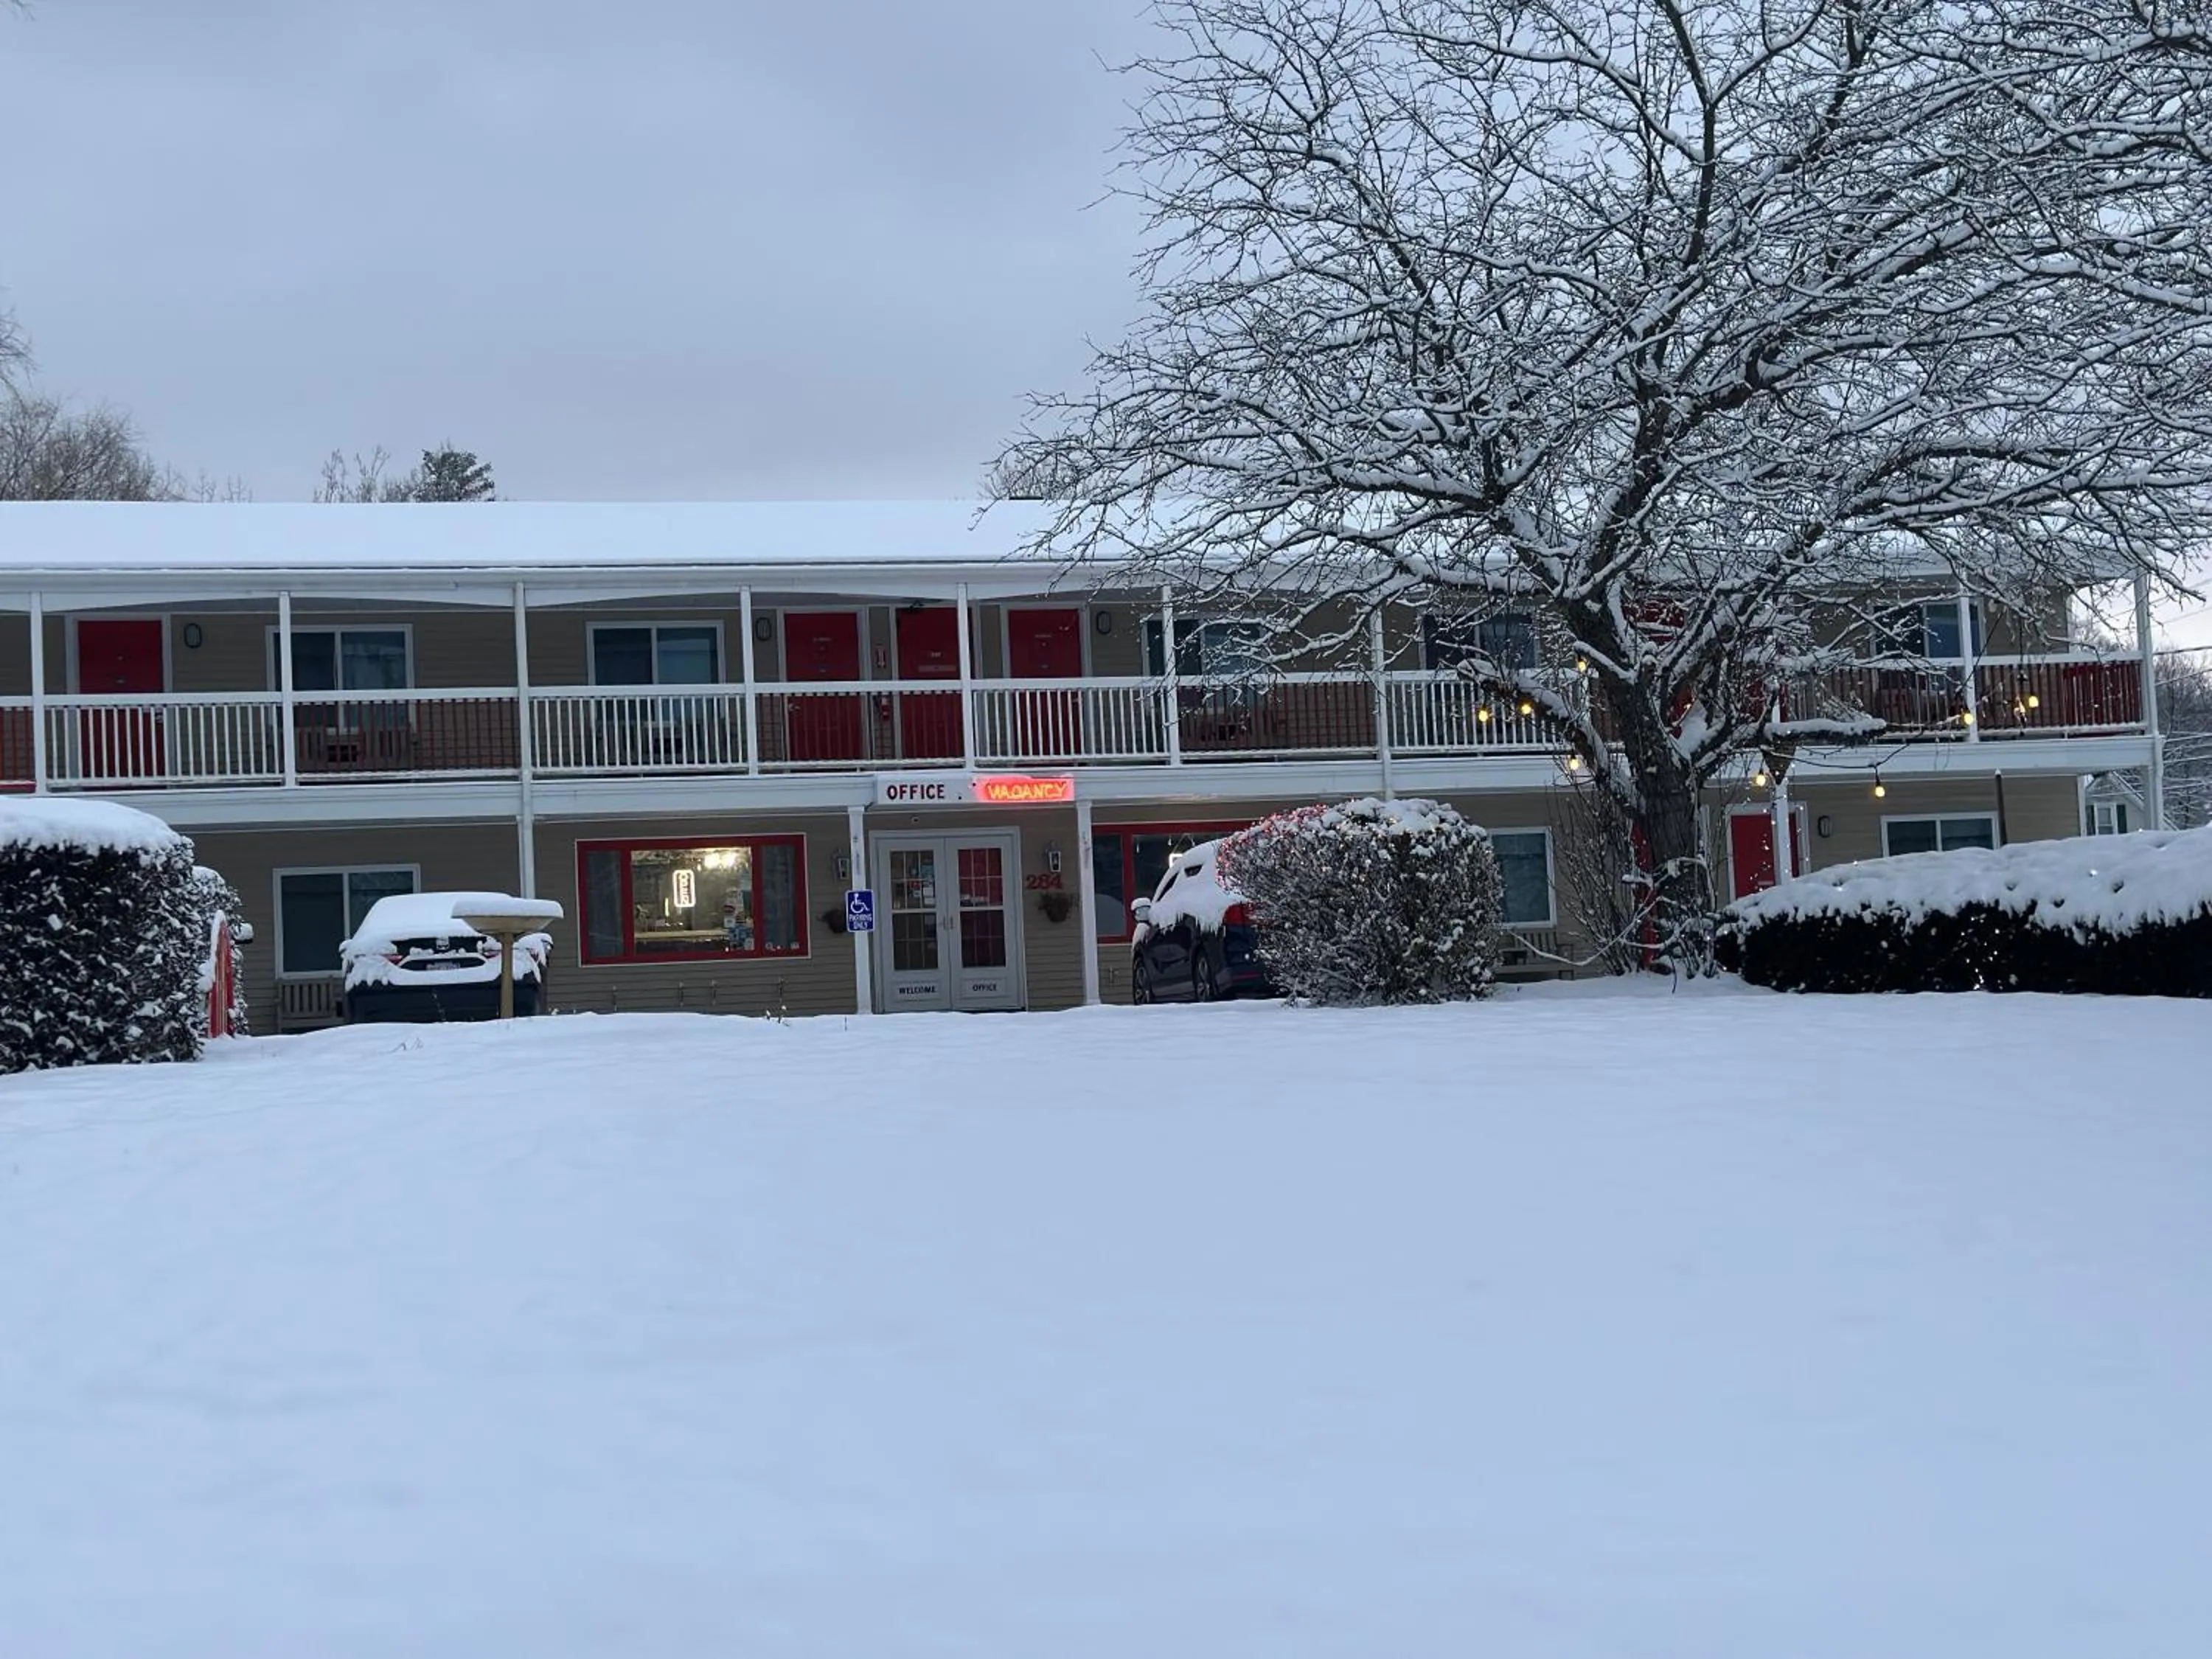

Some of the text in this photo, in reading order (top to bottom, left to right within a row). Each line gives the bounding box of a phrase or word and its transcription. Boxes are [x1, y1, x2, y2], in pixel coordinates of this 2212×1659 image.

[886, 784, 945, 800] OFFICE
[987, 782, 1067, 799] VACANCY
[1026, 874, 1062, 890] 284
[899, 985, 936, 995] WELCOME
[972, 984, 997, 992] OFFICE
